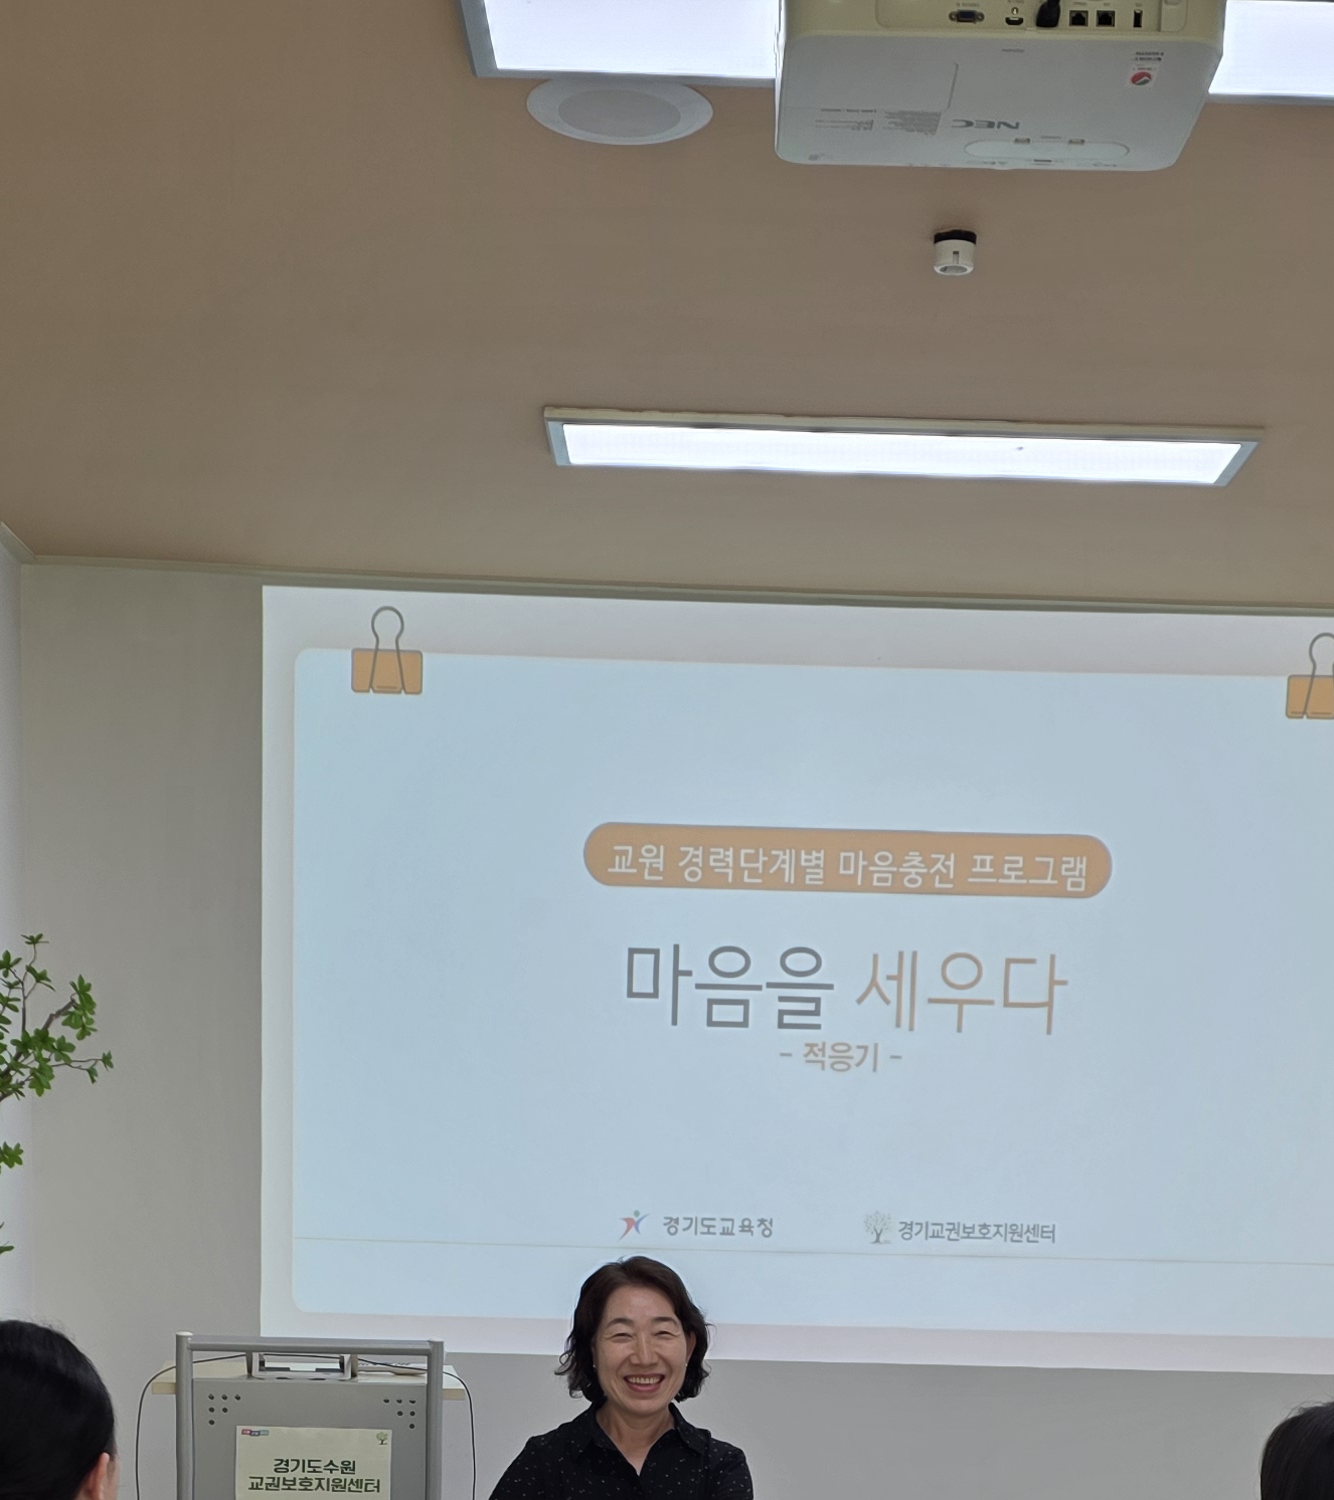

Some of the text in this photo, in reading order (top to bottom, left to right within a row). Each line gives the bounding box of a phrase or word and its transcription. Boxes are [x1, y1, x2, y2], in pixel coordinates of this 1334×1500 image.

[951, 118, 1020, 130] NEC
[607, 844, 1087, 892] 교원 경력단계별 마음충전 프로그램
[626, 943, 1069, 1035] 마음을 세우다
[803, 1040, 879, 1073] 적응기
[662, 1215, 774, 1239] 경기도교육청
[897, 1219, 1057, 1244] 경기교권보호지원센터
[273, 1458, 356, 1475] 경기도수원
[248, 1476, 381, 1493] 교권보호지원센터
